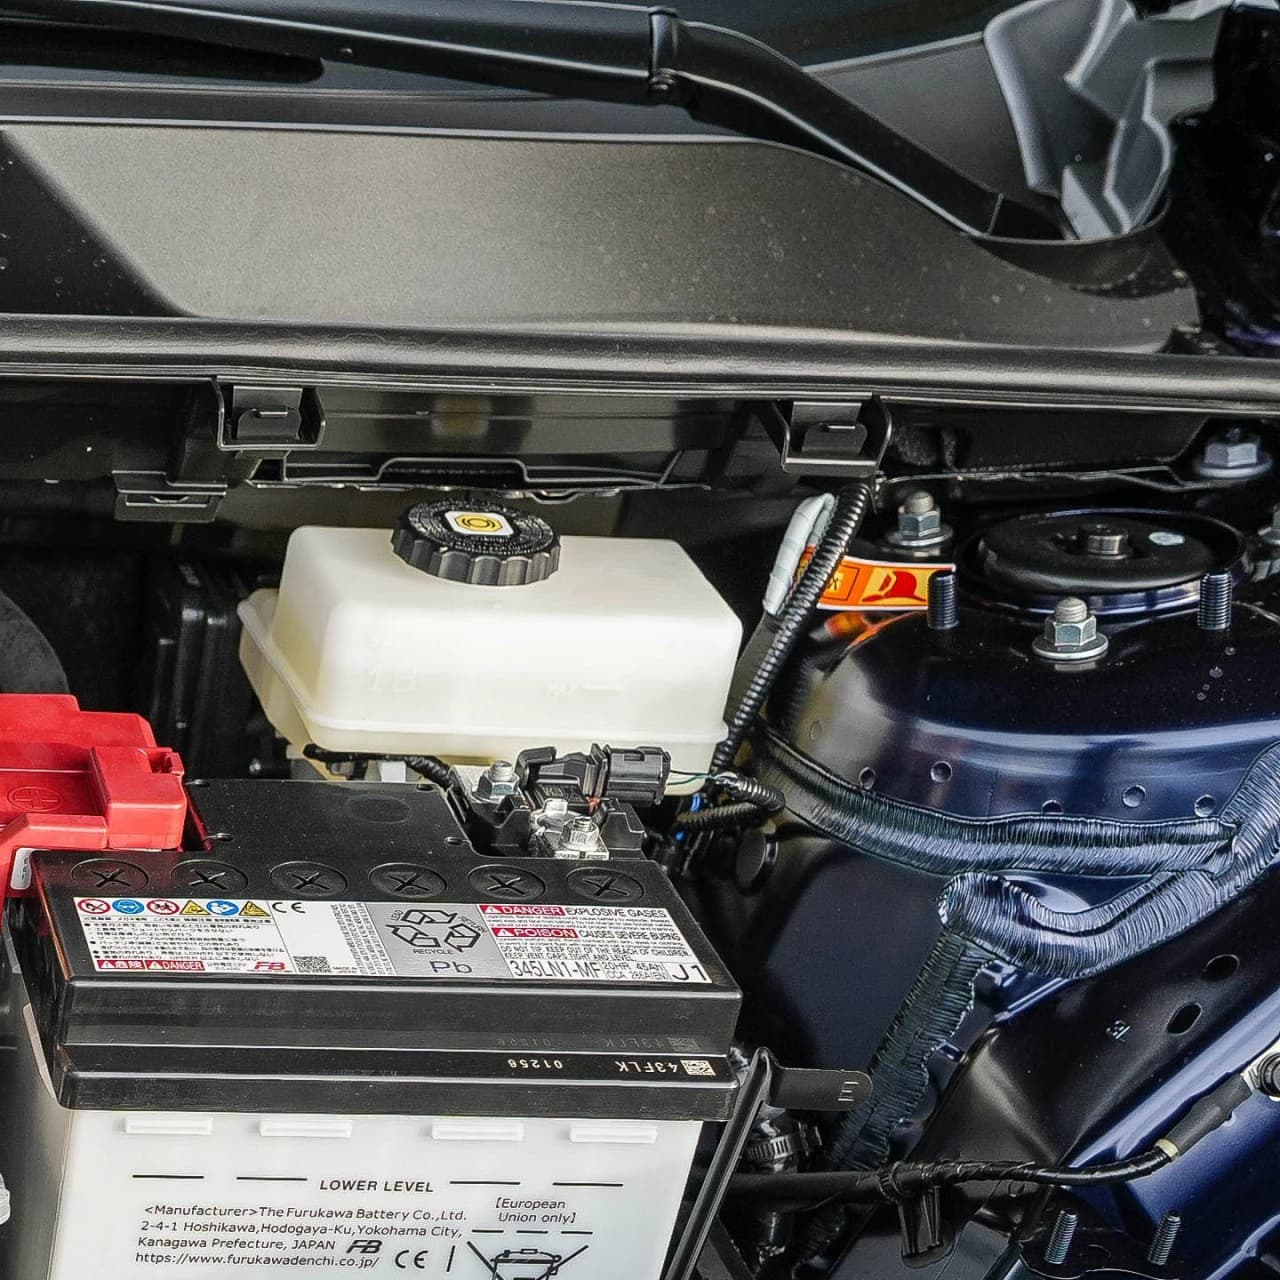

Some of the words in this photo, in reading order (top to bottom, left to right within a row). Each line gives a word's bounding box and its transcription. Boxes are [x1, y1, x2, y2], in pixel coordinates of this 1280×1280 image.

[501, 906, 561, 915] DANGER
[565, 908, 627, 917] EXPLOSIVE
[627, 908, 668, 918] GASES
[513, 927, 576, 938] POISON
[579, 930, 615, 939] CAUSES
[615, 931, 648, 940] SEVERE
[504, 952, 523, 960] KEEP
[162, 960, 203, 970] DANGER
[429, 960, 473, 974] Pb
[509, 960, 601, 978] 345LN1-MF
[601, 961, 630, 971] 20HR
[671, 964, 708, 981] J1
[319, 1179, 378, 1193] LOWER
[383, 1180, 435, 1193] LEVEL
[286, 1206, 354, 1220] Furukawa
[355, 1208, 410, 1223] Battery
[412, 1208, 467, 1223] Co.,Ltd.
[497, 1211, 538, 1224] Union
[140, 1220, 179, 1233] 2-4-1
[430, 1225, 463, 1239] City,
[137, 1236, 208, 1253] Kanagawa
[211, 1237, 289, 1252] Prefecture,
[290, 1238, 337, 1251] JAPAN
[134, 1252, 380, 1270] https://www.furukawadenchi.co.jp/
